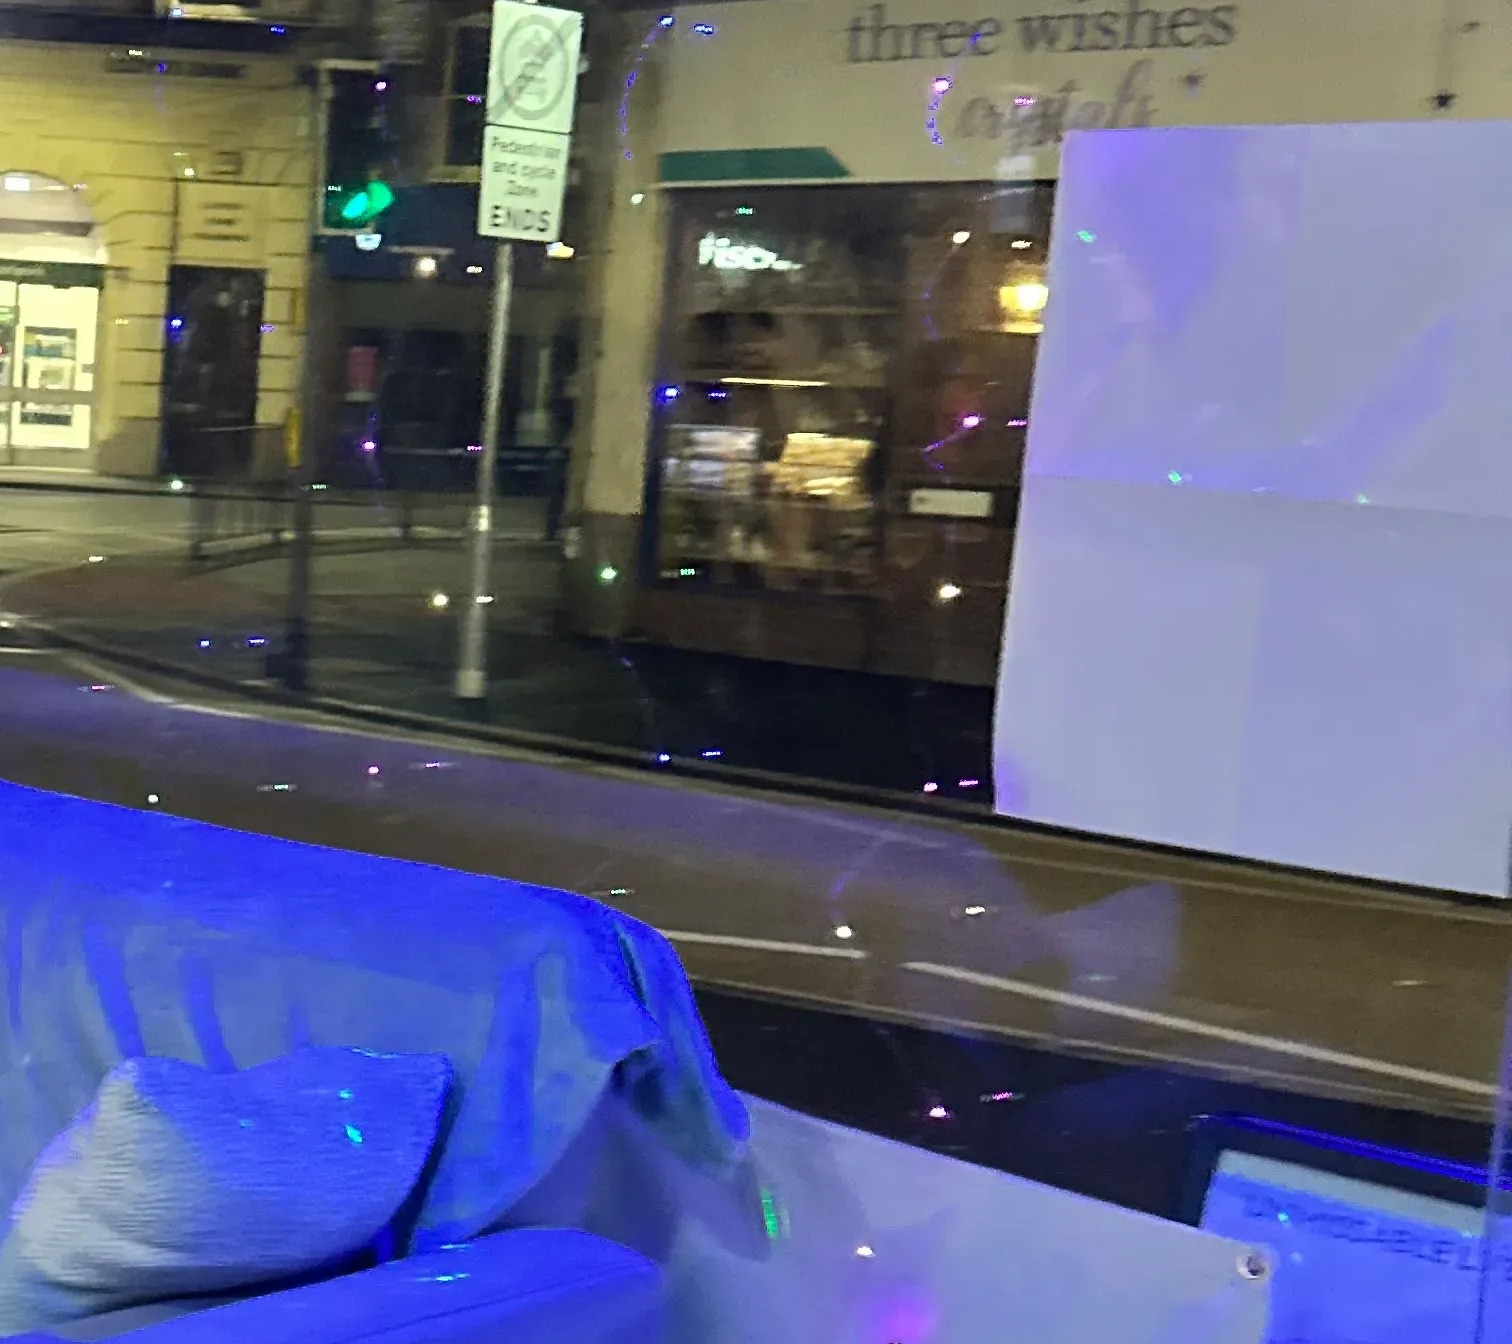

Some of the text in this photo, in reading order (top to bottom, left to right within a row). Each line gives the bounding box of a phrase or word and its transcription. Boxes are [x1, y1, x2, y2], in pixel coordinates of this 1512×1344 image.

[845, 3, 1002, 62] three
[492, 161, 518, 175] and
[489, 204, 553, 233] ENDS
